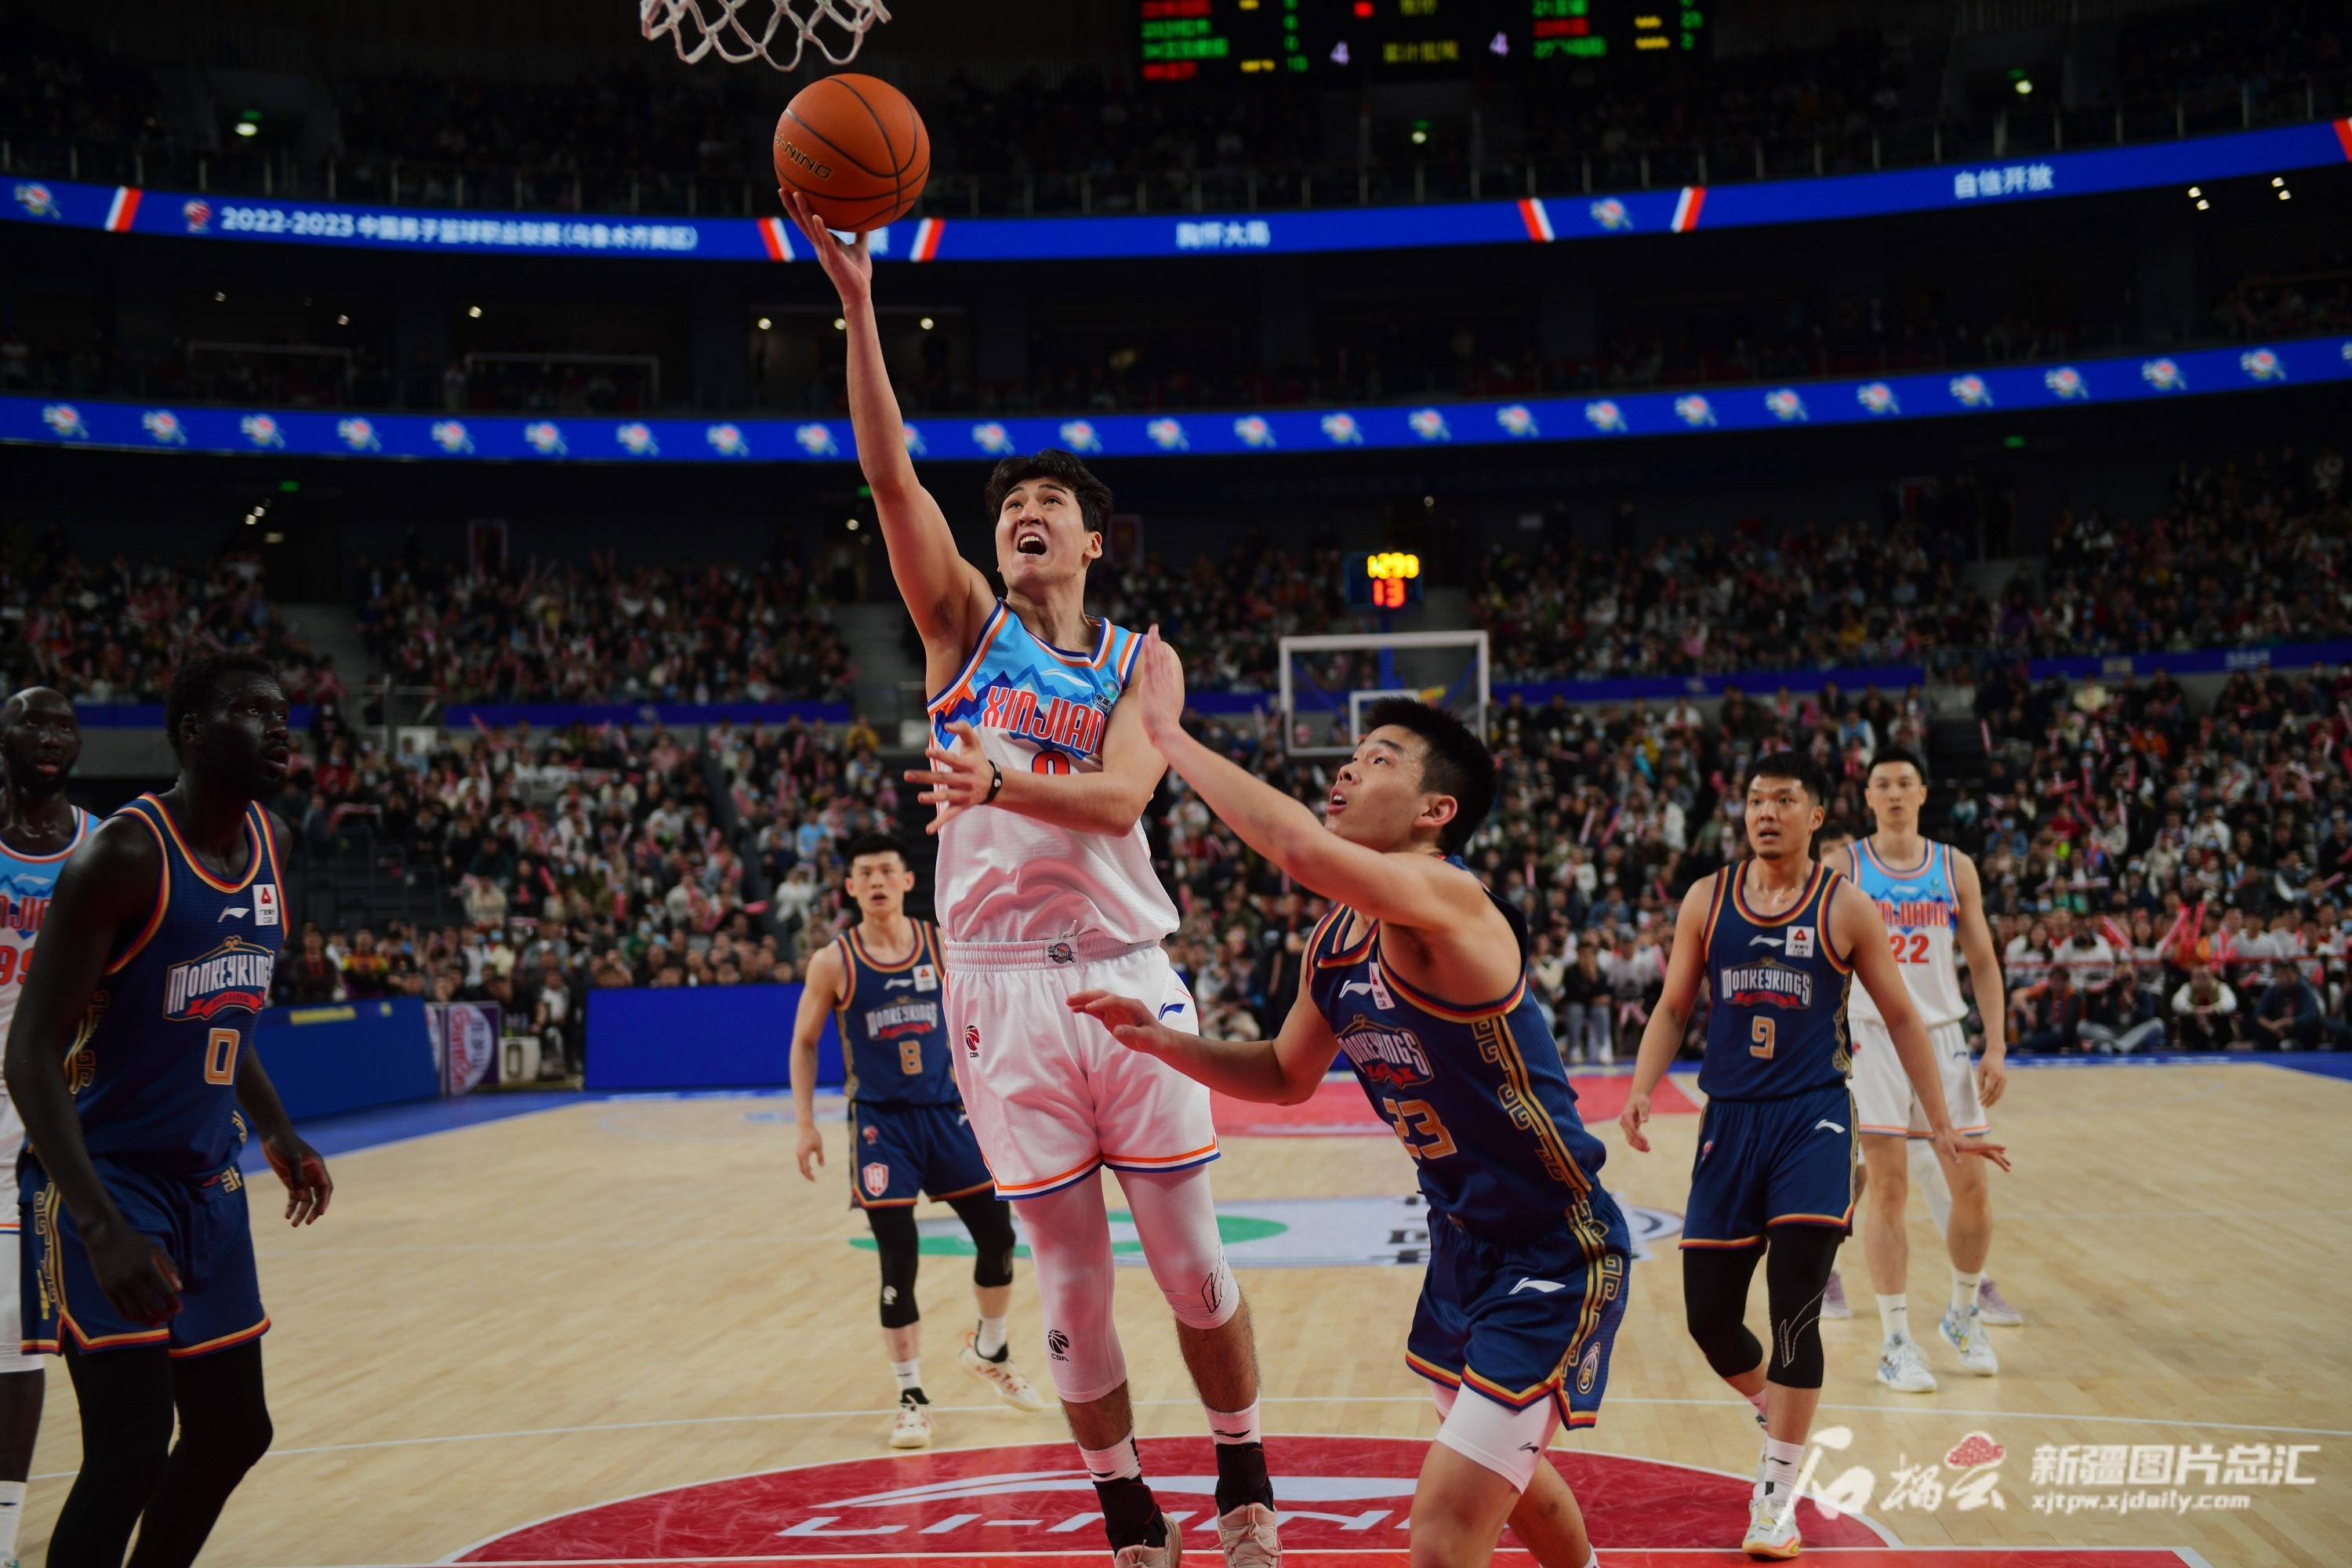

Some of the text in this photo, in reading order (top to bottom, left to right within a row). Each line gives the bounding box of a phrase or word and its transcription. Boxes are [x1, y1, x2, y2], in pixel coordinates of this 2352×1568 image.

[1330, 41, 1349, 65] 4
[1490, 31, 1508, 56] 4
[1955, 162, 2054, 198] 自信开放
[221, 206, 354, 237] 2022-2023
[984, 684, 1104, 755] XINJIAN
[1875, 900, 1950, 927] NJIANG
[1889, 934, 1929, 964] 22
[1722, 968, 1810, 1006] MONKEYKINGS
[1750, 1015, 1775, 1059] 9
[204, 1028, 240, 1085] 0
[898, 1040, 923, 1076] 8
[1382, 1097, 1457, 1160] 23
[776, 1511, 1411, 1537] LI-NIN
